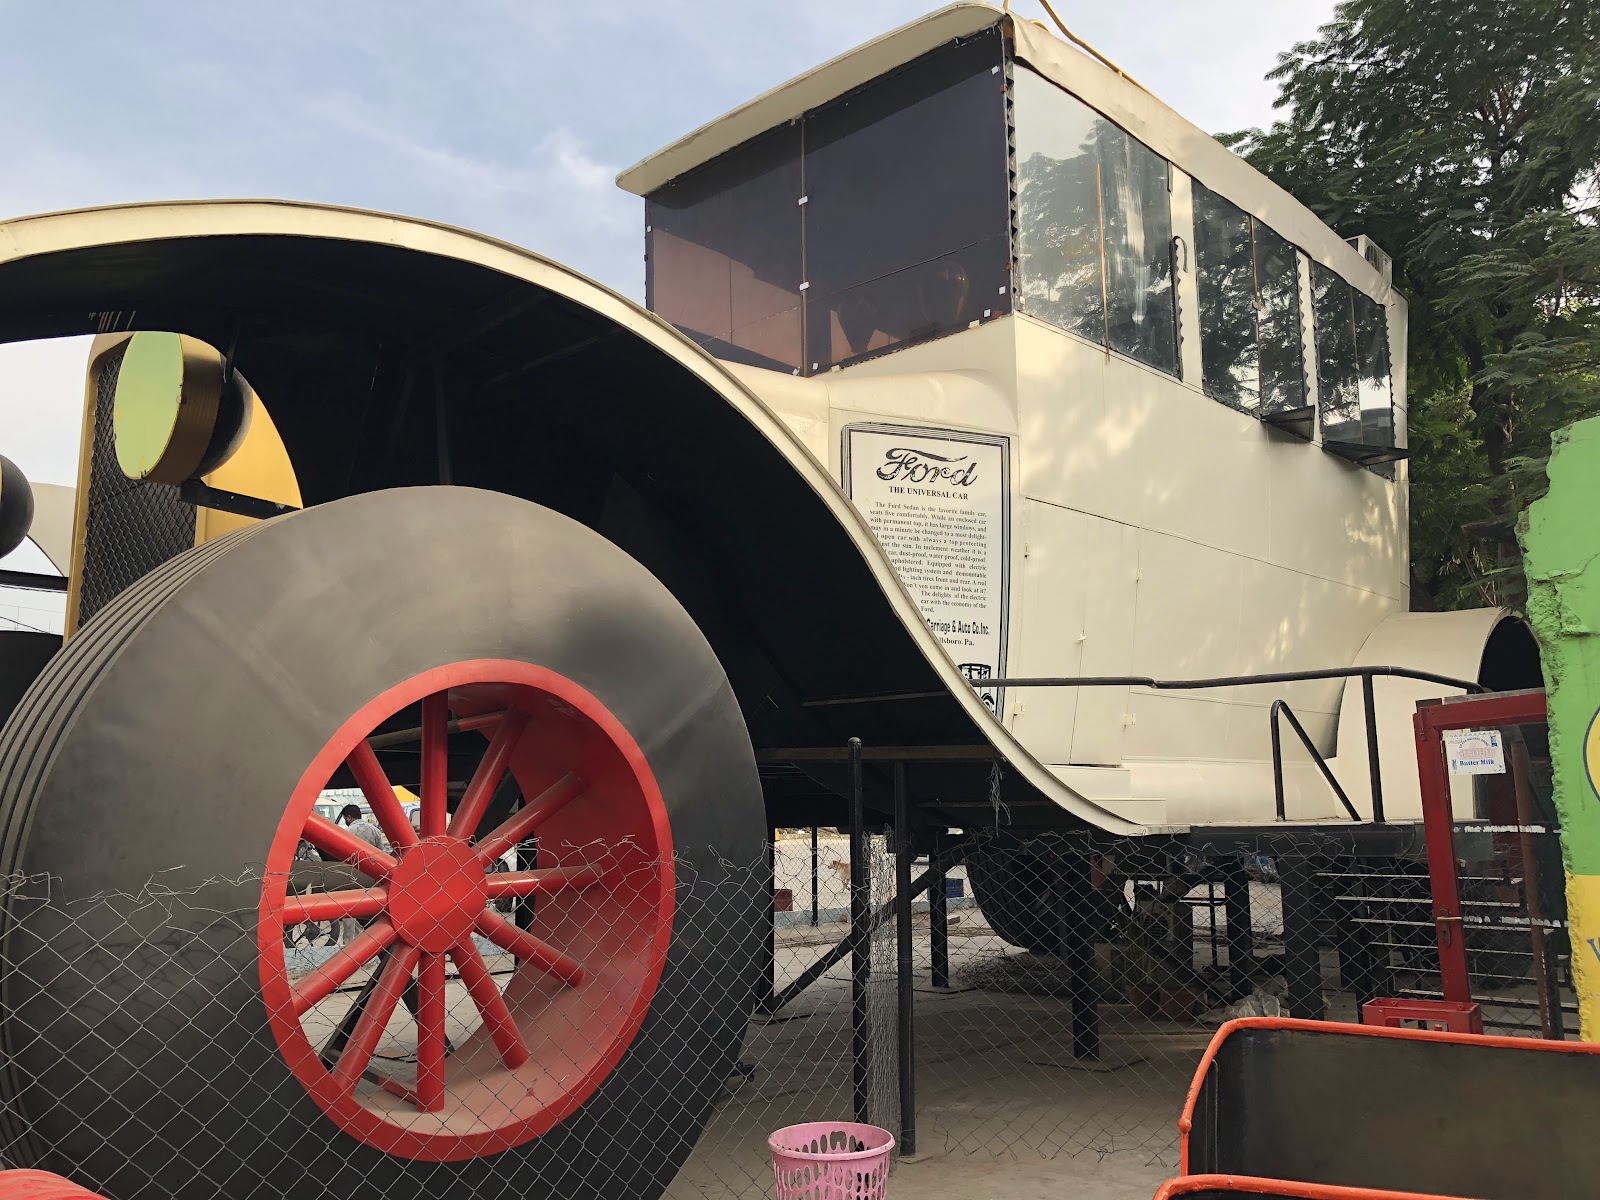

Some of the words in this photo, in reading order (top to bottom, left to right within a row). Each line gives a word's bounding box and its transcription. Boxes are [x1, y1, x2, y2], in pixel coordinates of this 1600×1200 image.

[876, 448, 978, 487] Ford
[889, 486, 906, 494] THE
[907, 488, 951, 498] UNIVERSAL
[952, 492, 969, 500] CAR
[960, 509, 976, 518] family
[927, 560, 952, 568] Equipped
[902, 566, 922, 574] lighting
[952, 620, 957, 633] &
[958, 620, 971, 634] Auto
